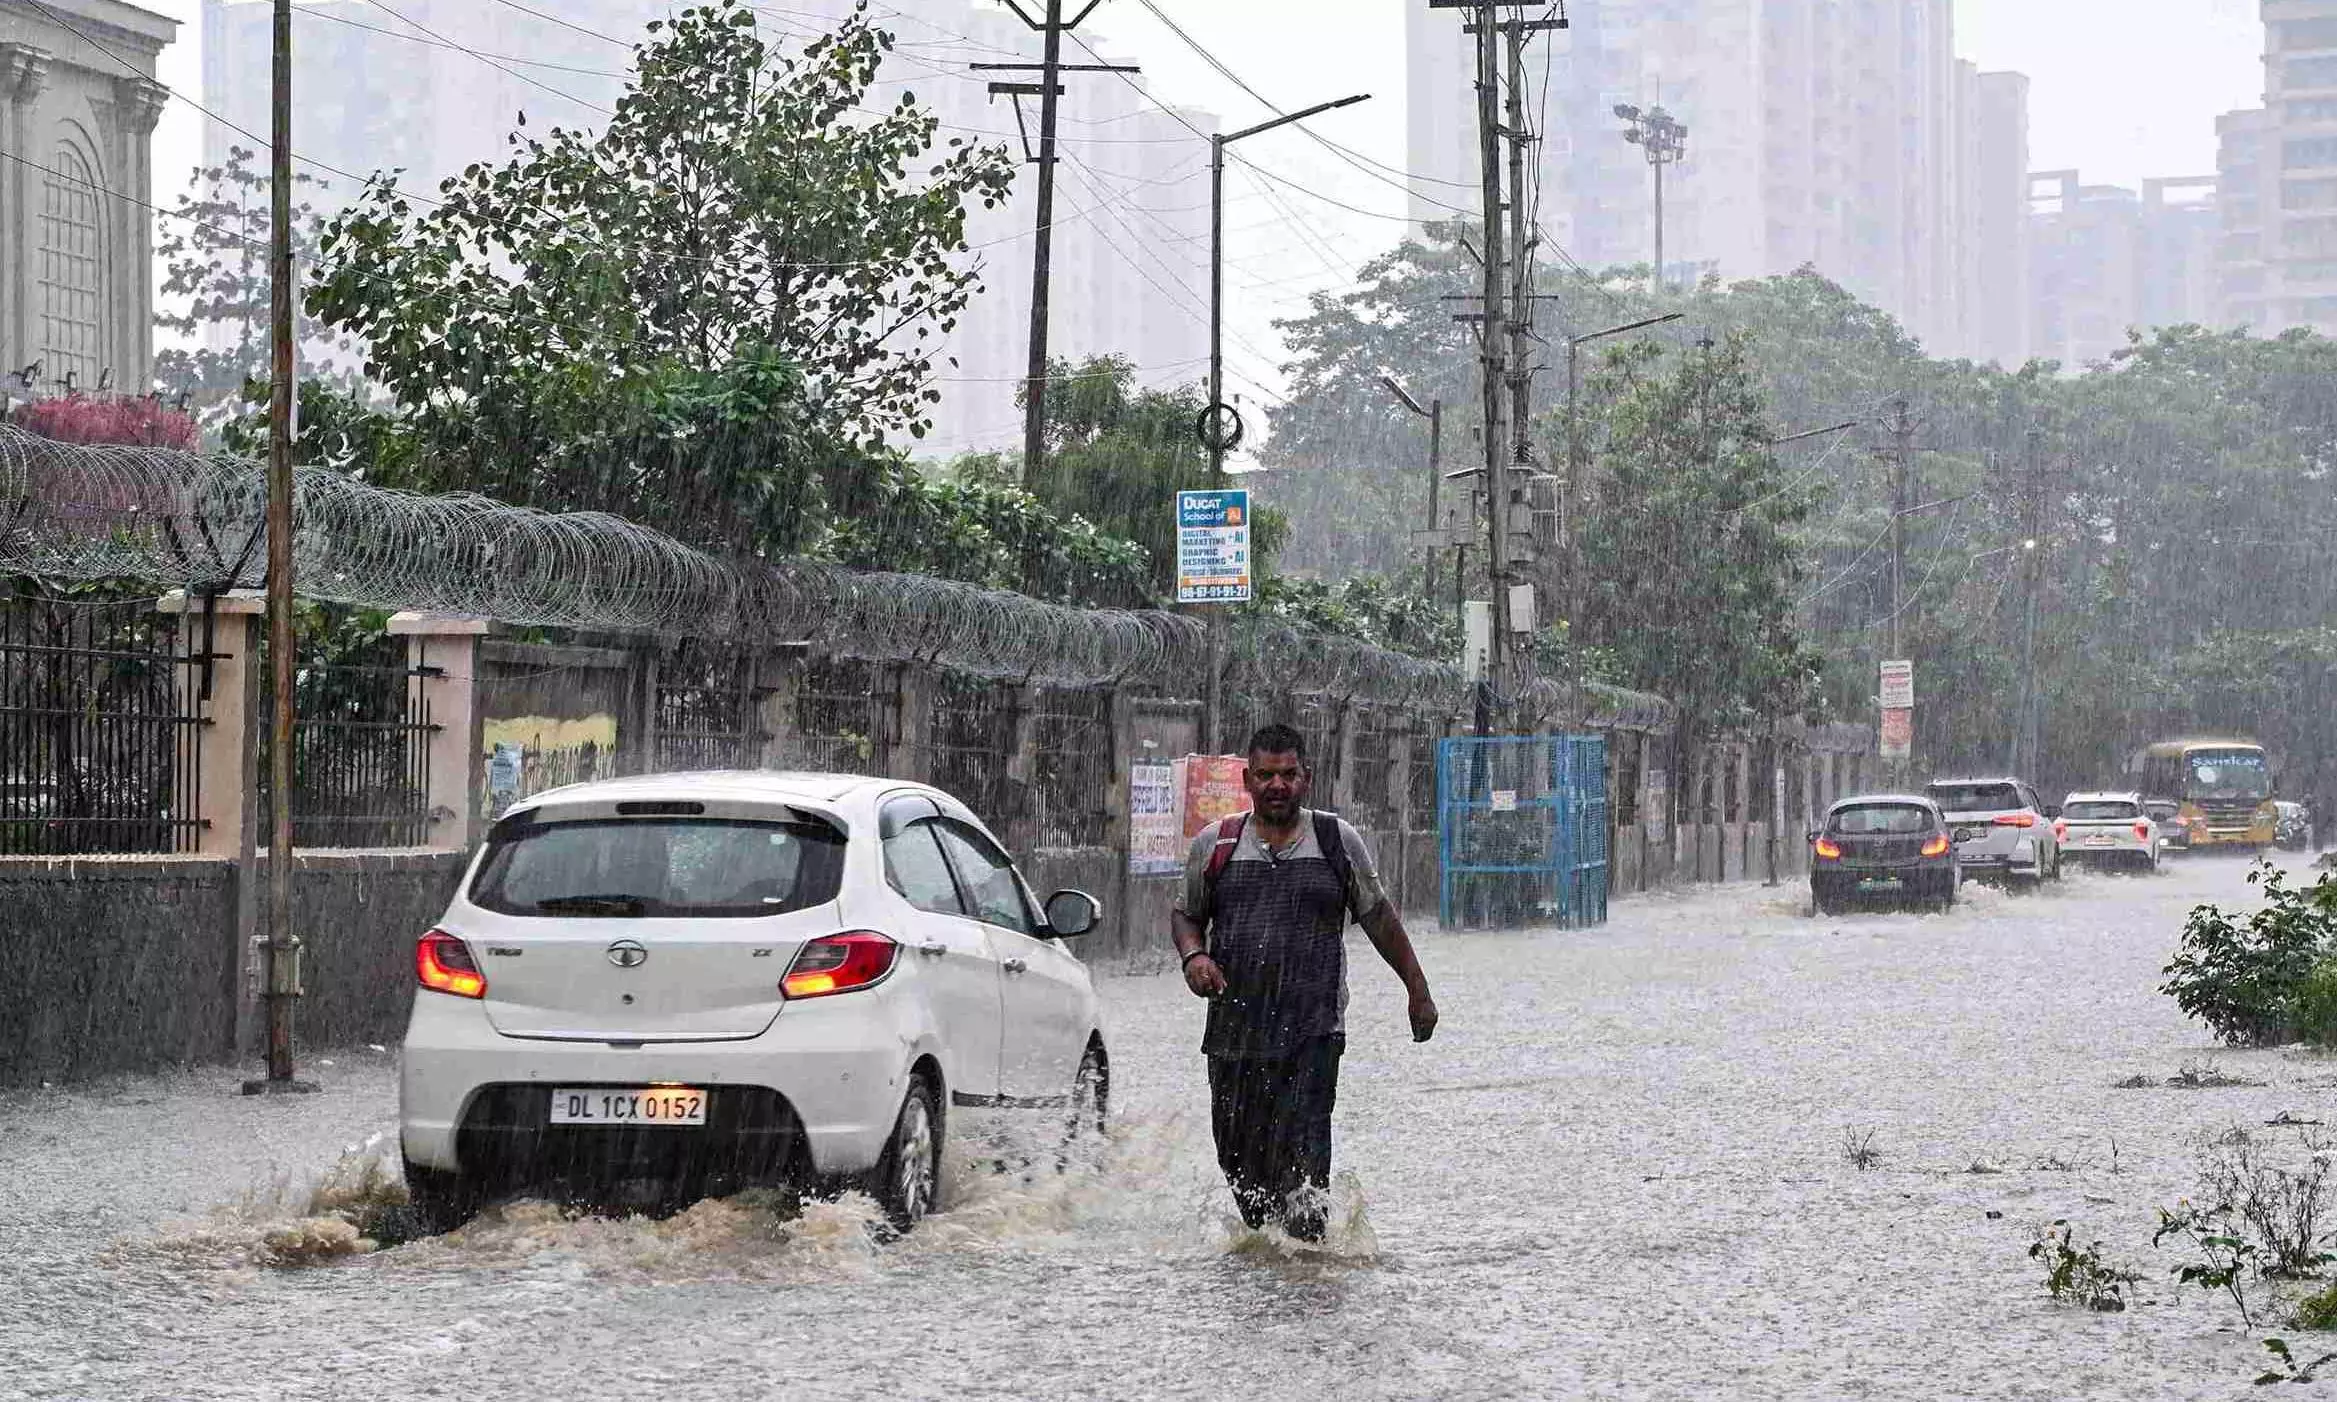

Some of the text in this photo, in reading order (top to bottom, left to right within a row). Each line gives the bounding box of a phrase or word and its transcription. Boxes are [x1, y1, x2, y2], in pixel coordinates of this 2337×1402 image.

[1183, 511, 1214, 520] School
[1216, 511, 1225, 520] of
[1182, 548, 1218, 556] GRAPHIC
[1182, 558, 1226, 566] DESIGNING
[568, 1095, 700, 1119] DL 1CX 0152
